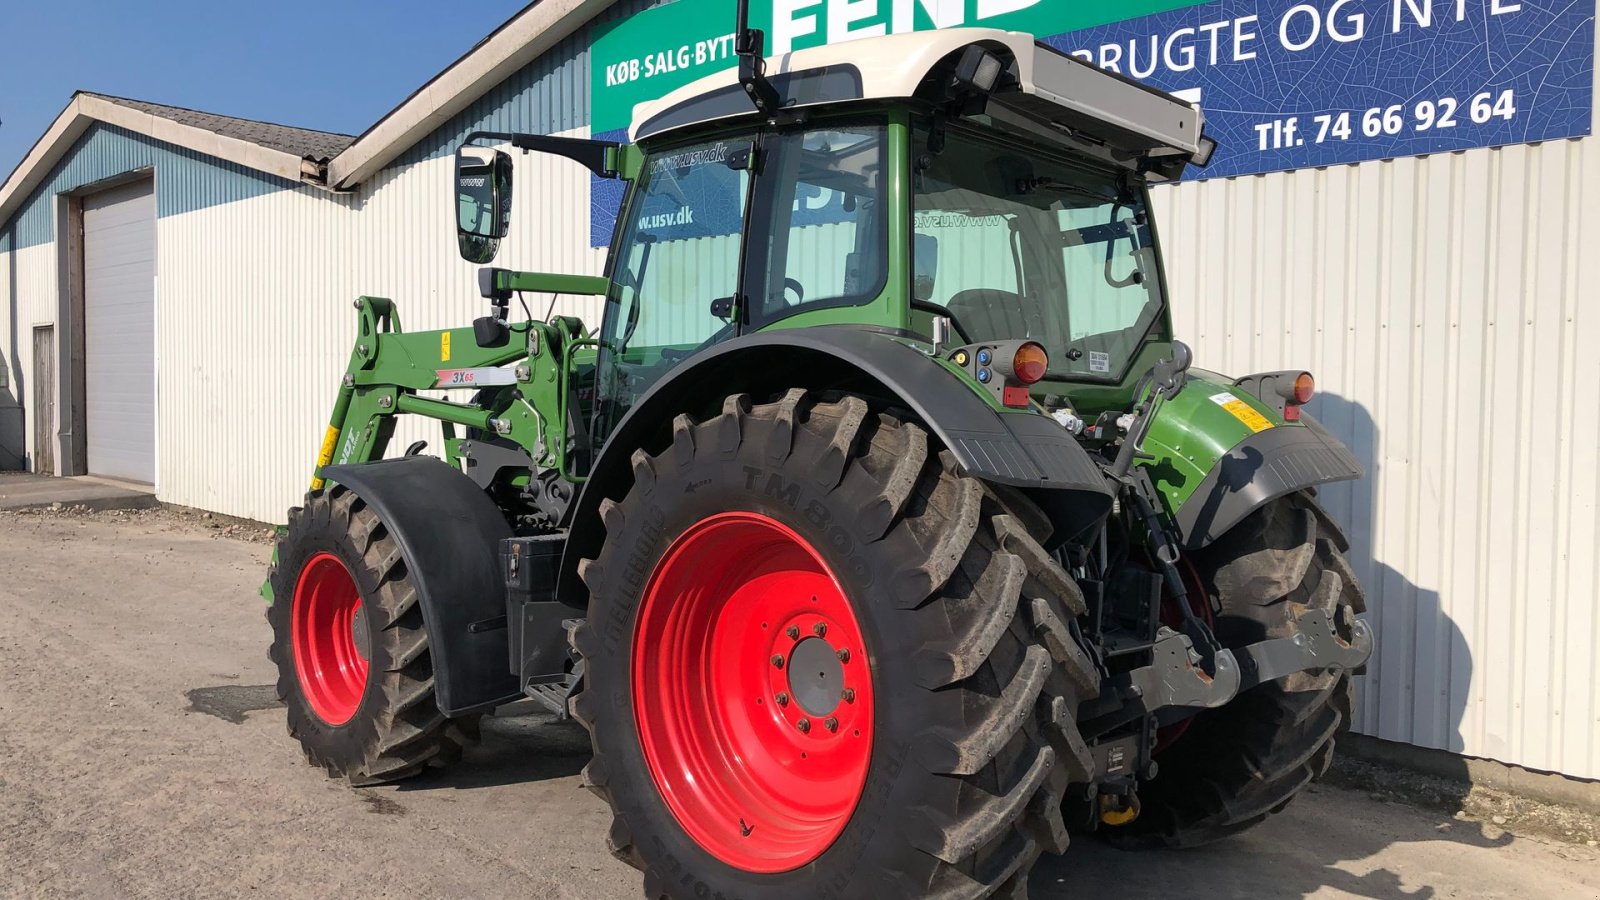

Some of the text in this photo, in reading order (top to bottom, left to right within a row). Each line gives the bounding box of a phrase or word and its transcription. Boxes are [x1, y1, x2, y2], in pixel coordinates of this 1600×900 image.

[1279, 0, 1364, 51] OG
[1255, 89, 1515, 150] Tlf. 74 66 92 64
[649, 142, 727, 175] www.usv.dk
